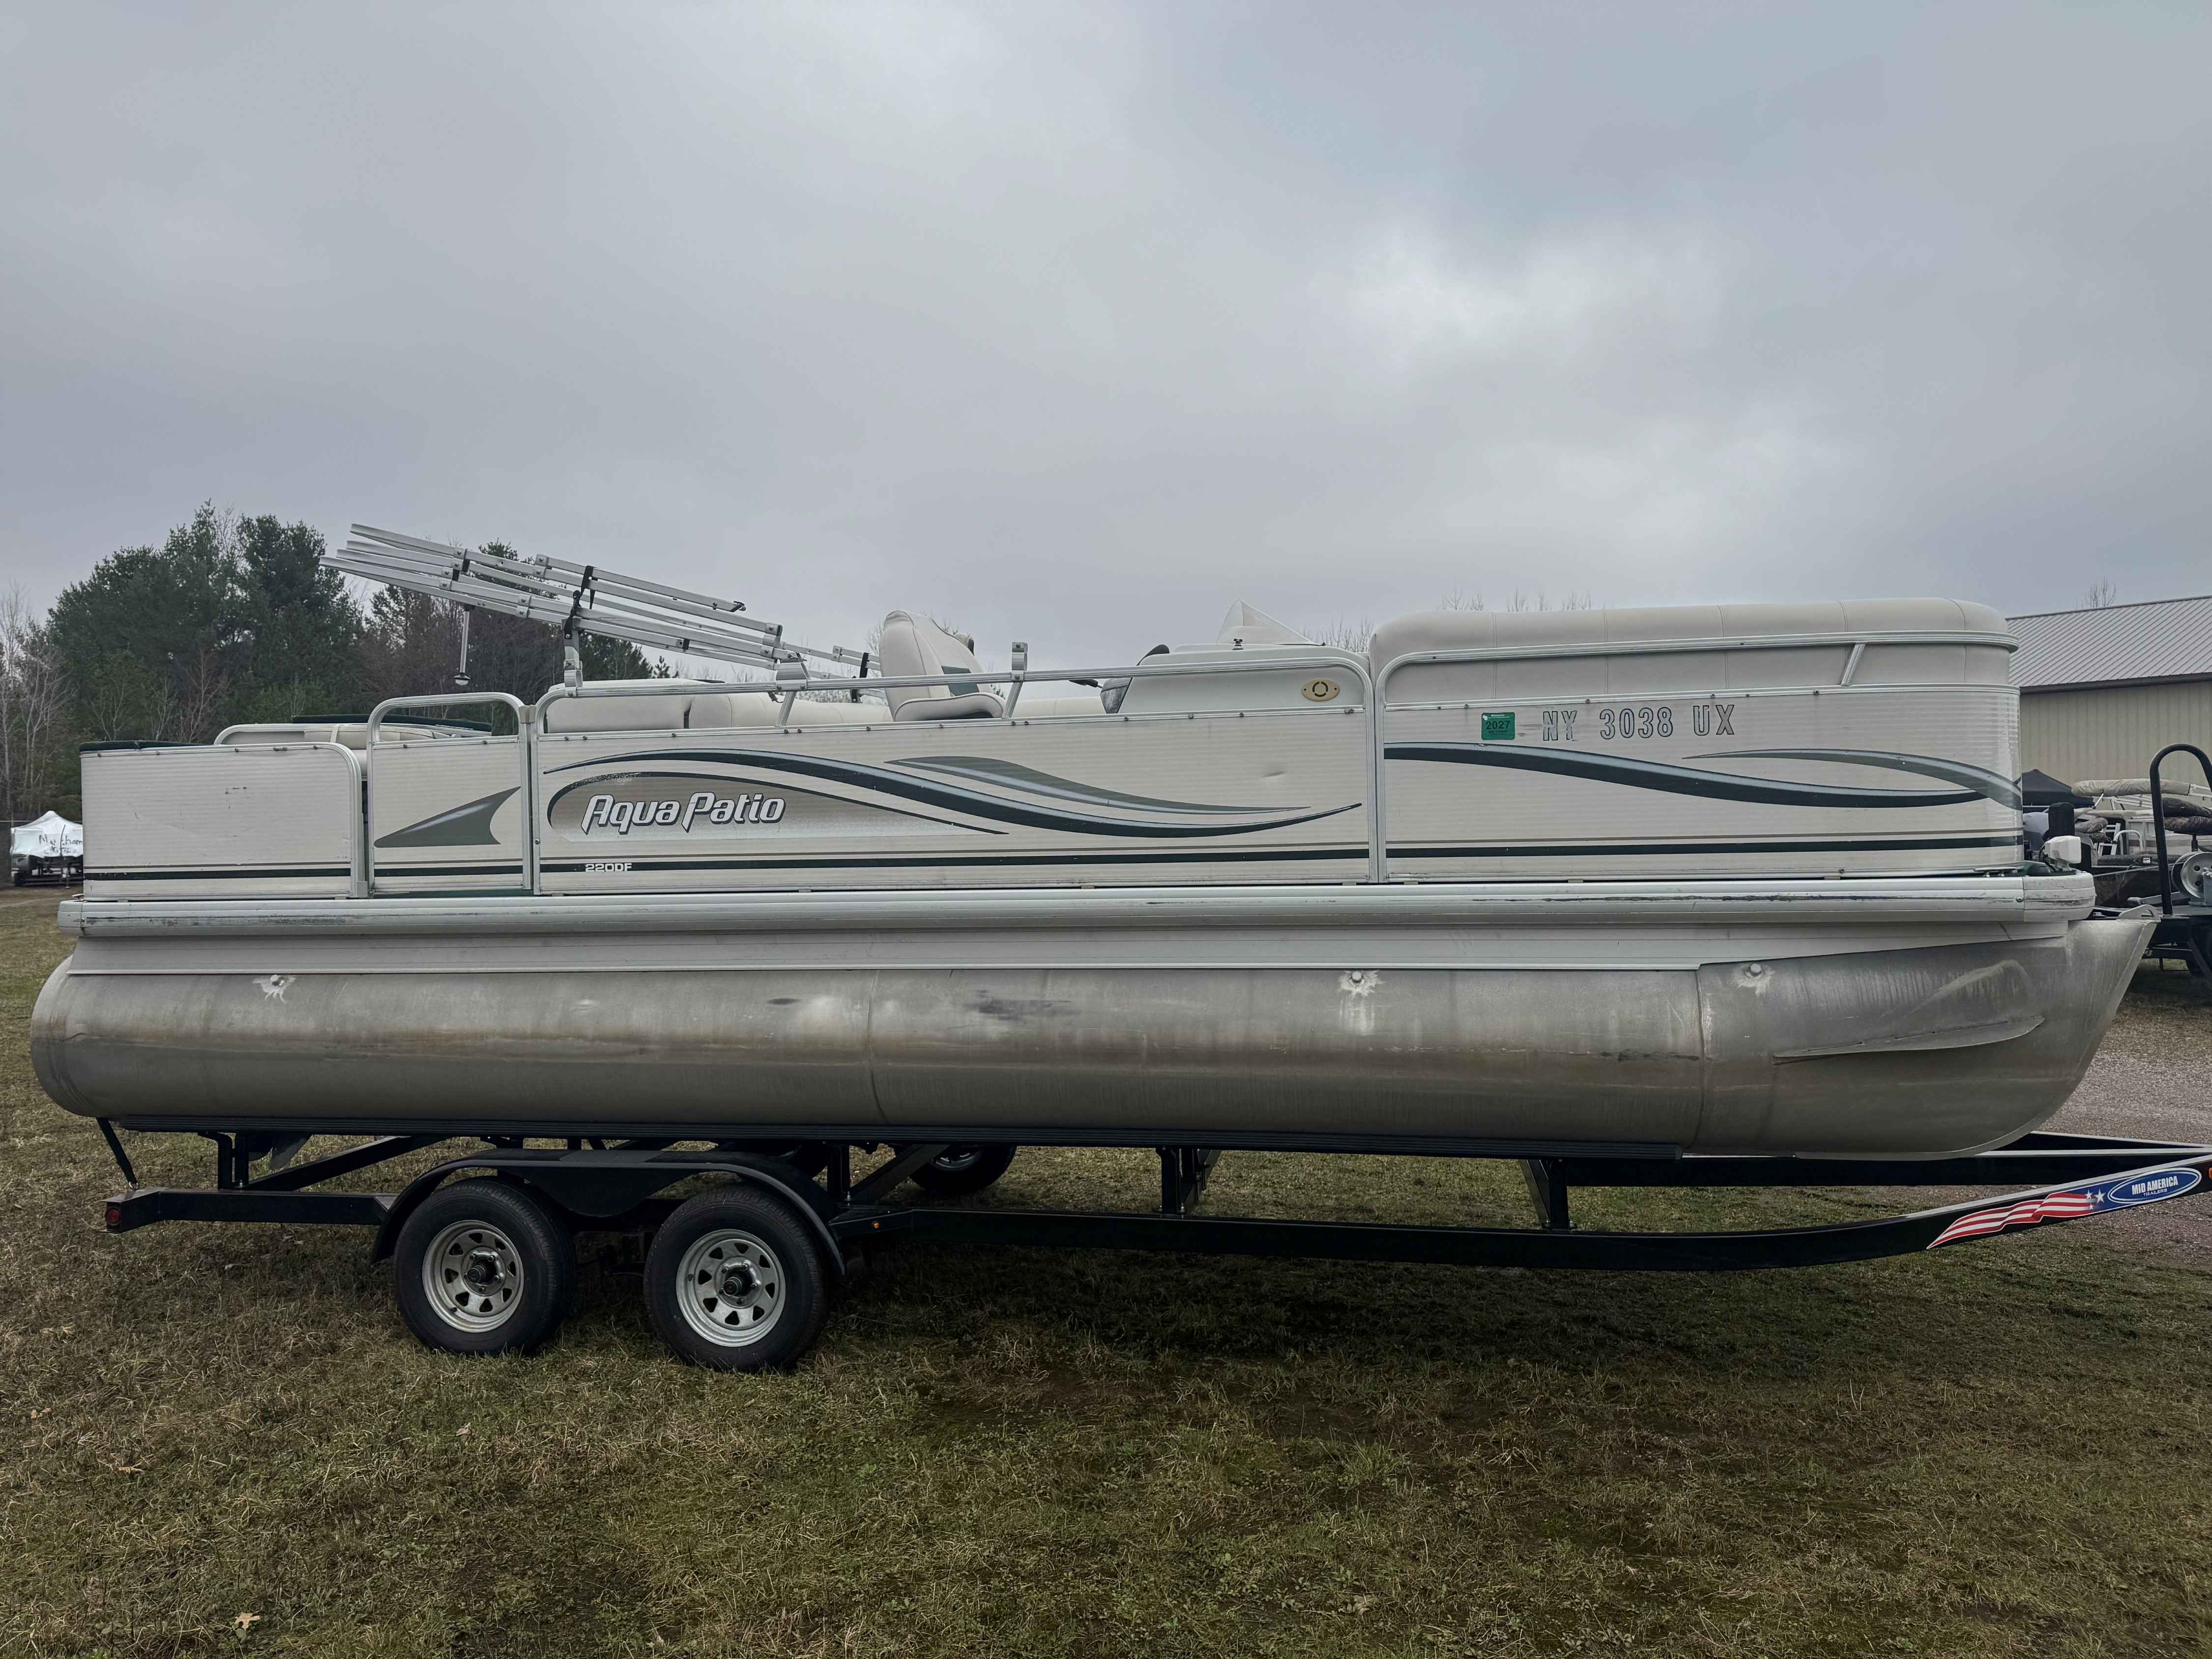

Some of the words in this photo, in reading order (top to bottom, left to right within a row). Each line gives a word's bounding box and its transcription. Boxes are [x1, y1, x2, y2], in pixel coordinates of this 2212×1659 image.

[1486, 721, 1510, 729] 2027
[1543, 711, 1577, 741] NY
[1600, 707, 1673, 739] 3038
[1693, 704, 1735, 736] UX
[581, 794, 681, 835] Aqua
[681, 792, 786, 833] Patio
[585, 863, 632, 872] 220DF
[2131, 1183, 2146, 1195] MID
[2147, 1176, 2179, 1191] AMERICA
[2143, 1188, 2168, 1197] TRAILERS
